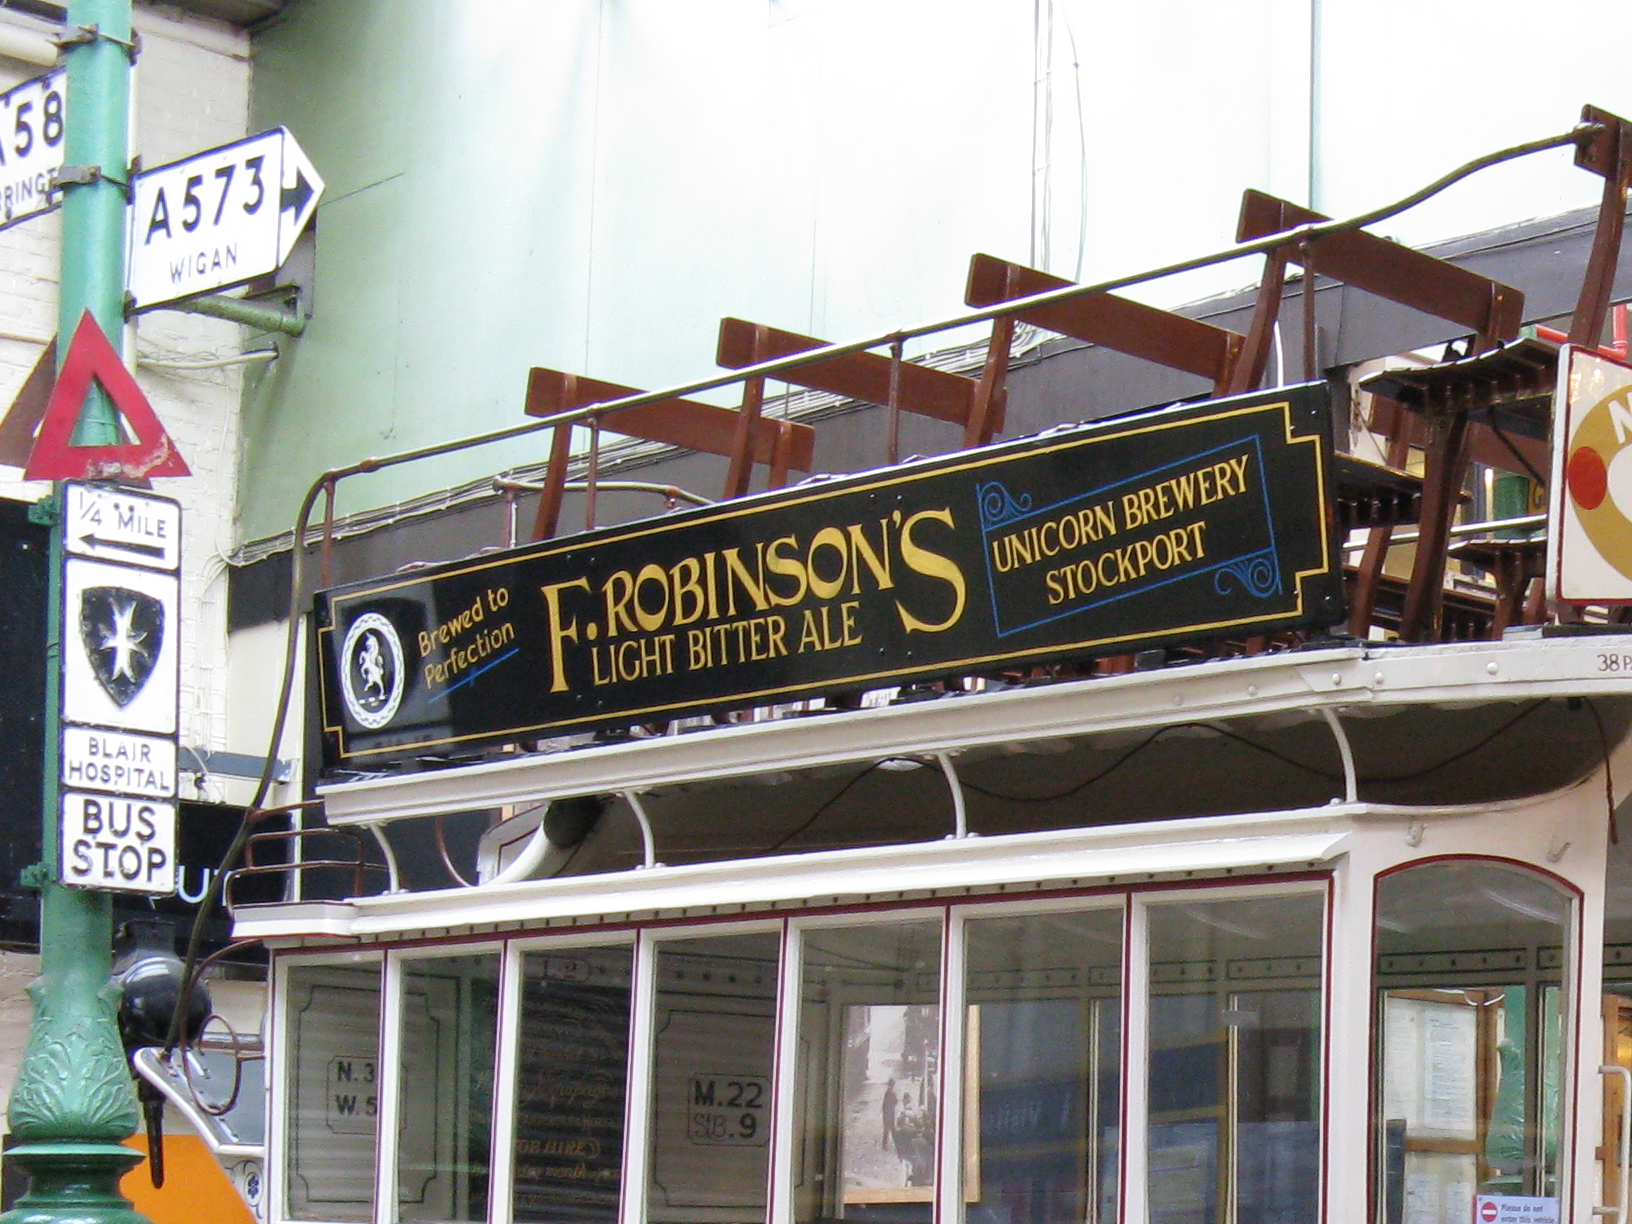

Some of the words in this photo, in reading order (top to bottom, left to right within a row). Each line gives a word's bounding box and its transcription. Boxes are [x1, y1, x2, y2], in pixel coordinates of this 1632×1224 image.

[0, 90, 63, 166] 58
[145, 155, 267, 246] A573
[170, 242, 238, 284] WIGAN
[118, 511, 168, 540] MILE
[992, 502, 1117, 574] UNICORN
[1123, 453, 1251, 531] BREWERY
[602, 507, 967, 638] ROBINSON'S
[1045, 521, 1208, 605] STOCKPORT
[417, 598, 484, 659] Brewed
[487, 586, 510, 612] to
[591, 633, 675, 687] LIGHT
[689, 614, 788, 672] BITTER
[798, 601, 863, 655] ALE
[424, 619, 516, 691] Perfection
[1597, 653, 1619, 672] 38
[68, 760, 170, 792] HOSPITAL
[88, 736, 152, 763] BLAIR
[83, 798, 156, 842] BUS
[71, 839, 166, 883] STOP
[695, 1081, 763, 1108] M.22
